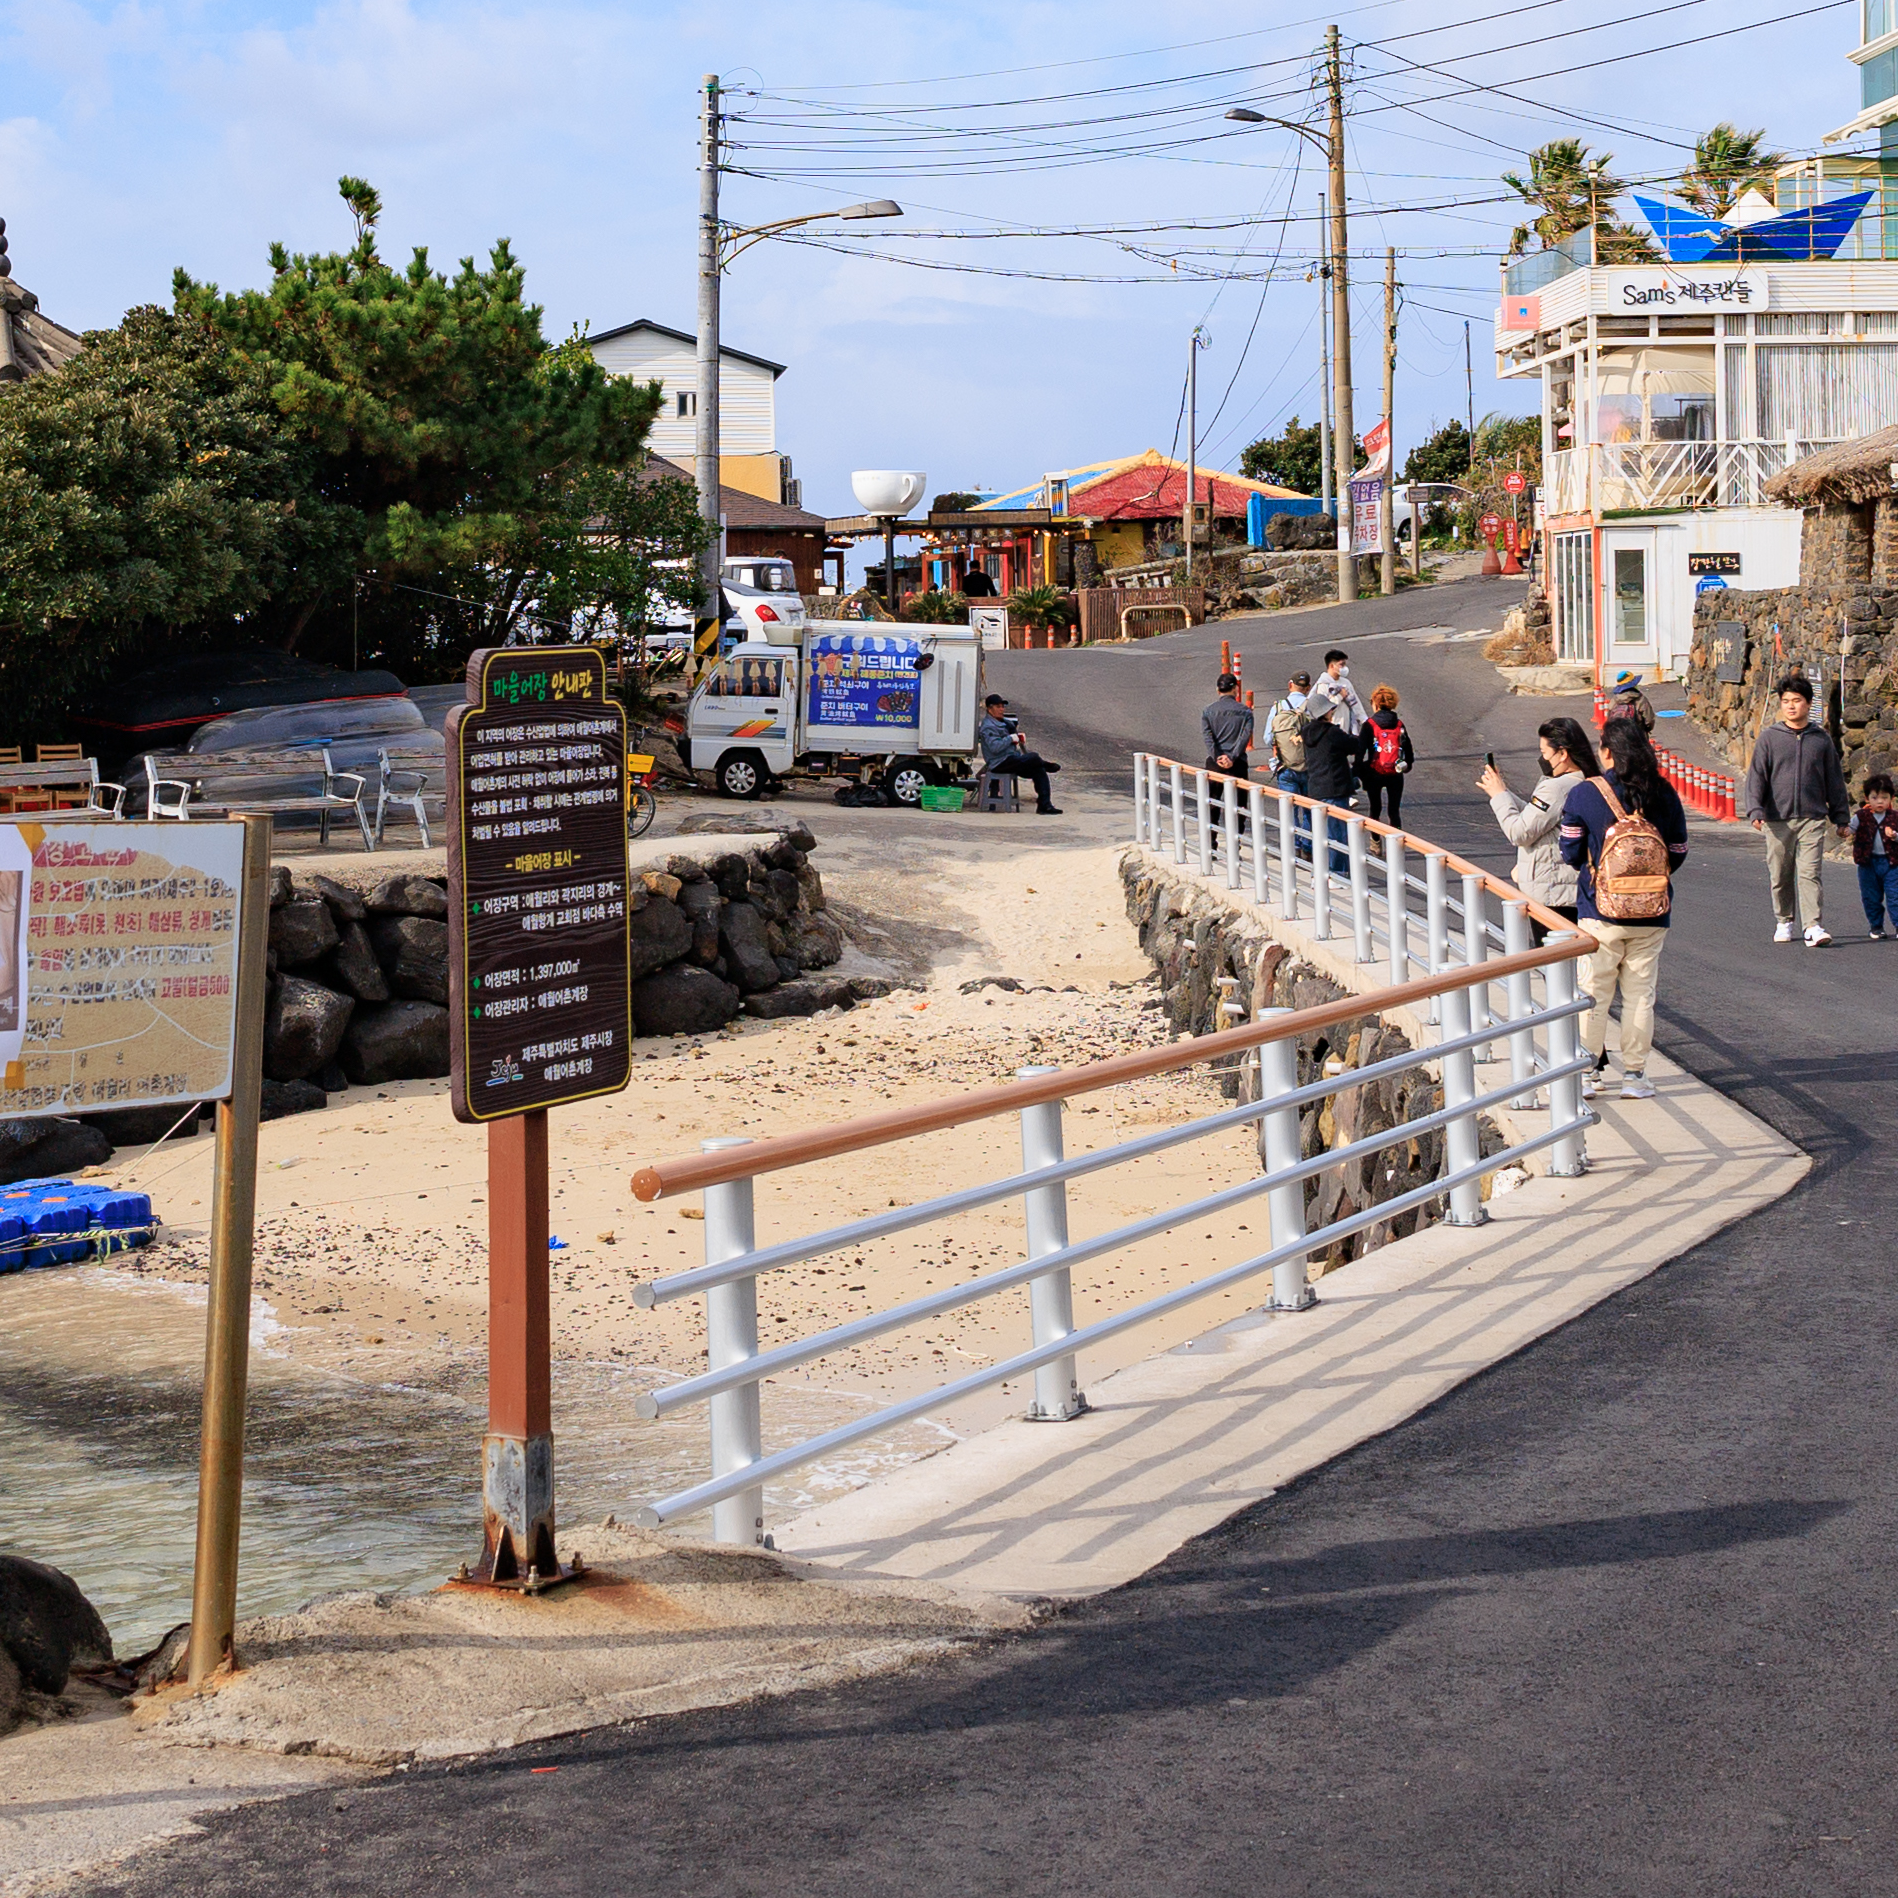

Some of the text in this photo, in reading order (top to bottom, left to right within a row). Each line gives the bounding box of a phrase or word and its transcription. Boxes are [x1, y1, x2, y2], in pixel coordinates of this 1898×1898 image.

[1623, 279, 1753, 306] Sam's 제주캔들
[493, 669, 593, 704] 마을어장 안내판
[515, 853, 551, 873] 마을어장
[553, 849, 572, 867] 표시
[484, 895, 519, 914] 어장구역
[562, 884, 594, 903] 곽지리의
[607, 901, 623, 919] 수역
[484, 968, 520, 989] 어장면적
[484, 996, 529, 1018] 어장관리자
[537, 985, 589, 1008] 애월어촌계장
[522, 1030, 613, 1062] 제주특별자치도 제주시장
[544, 1057, 593, 1082] 애월어촌계장
